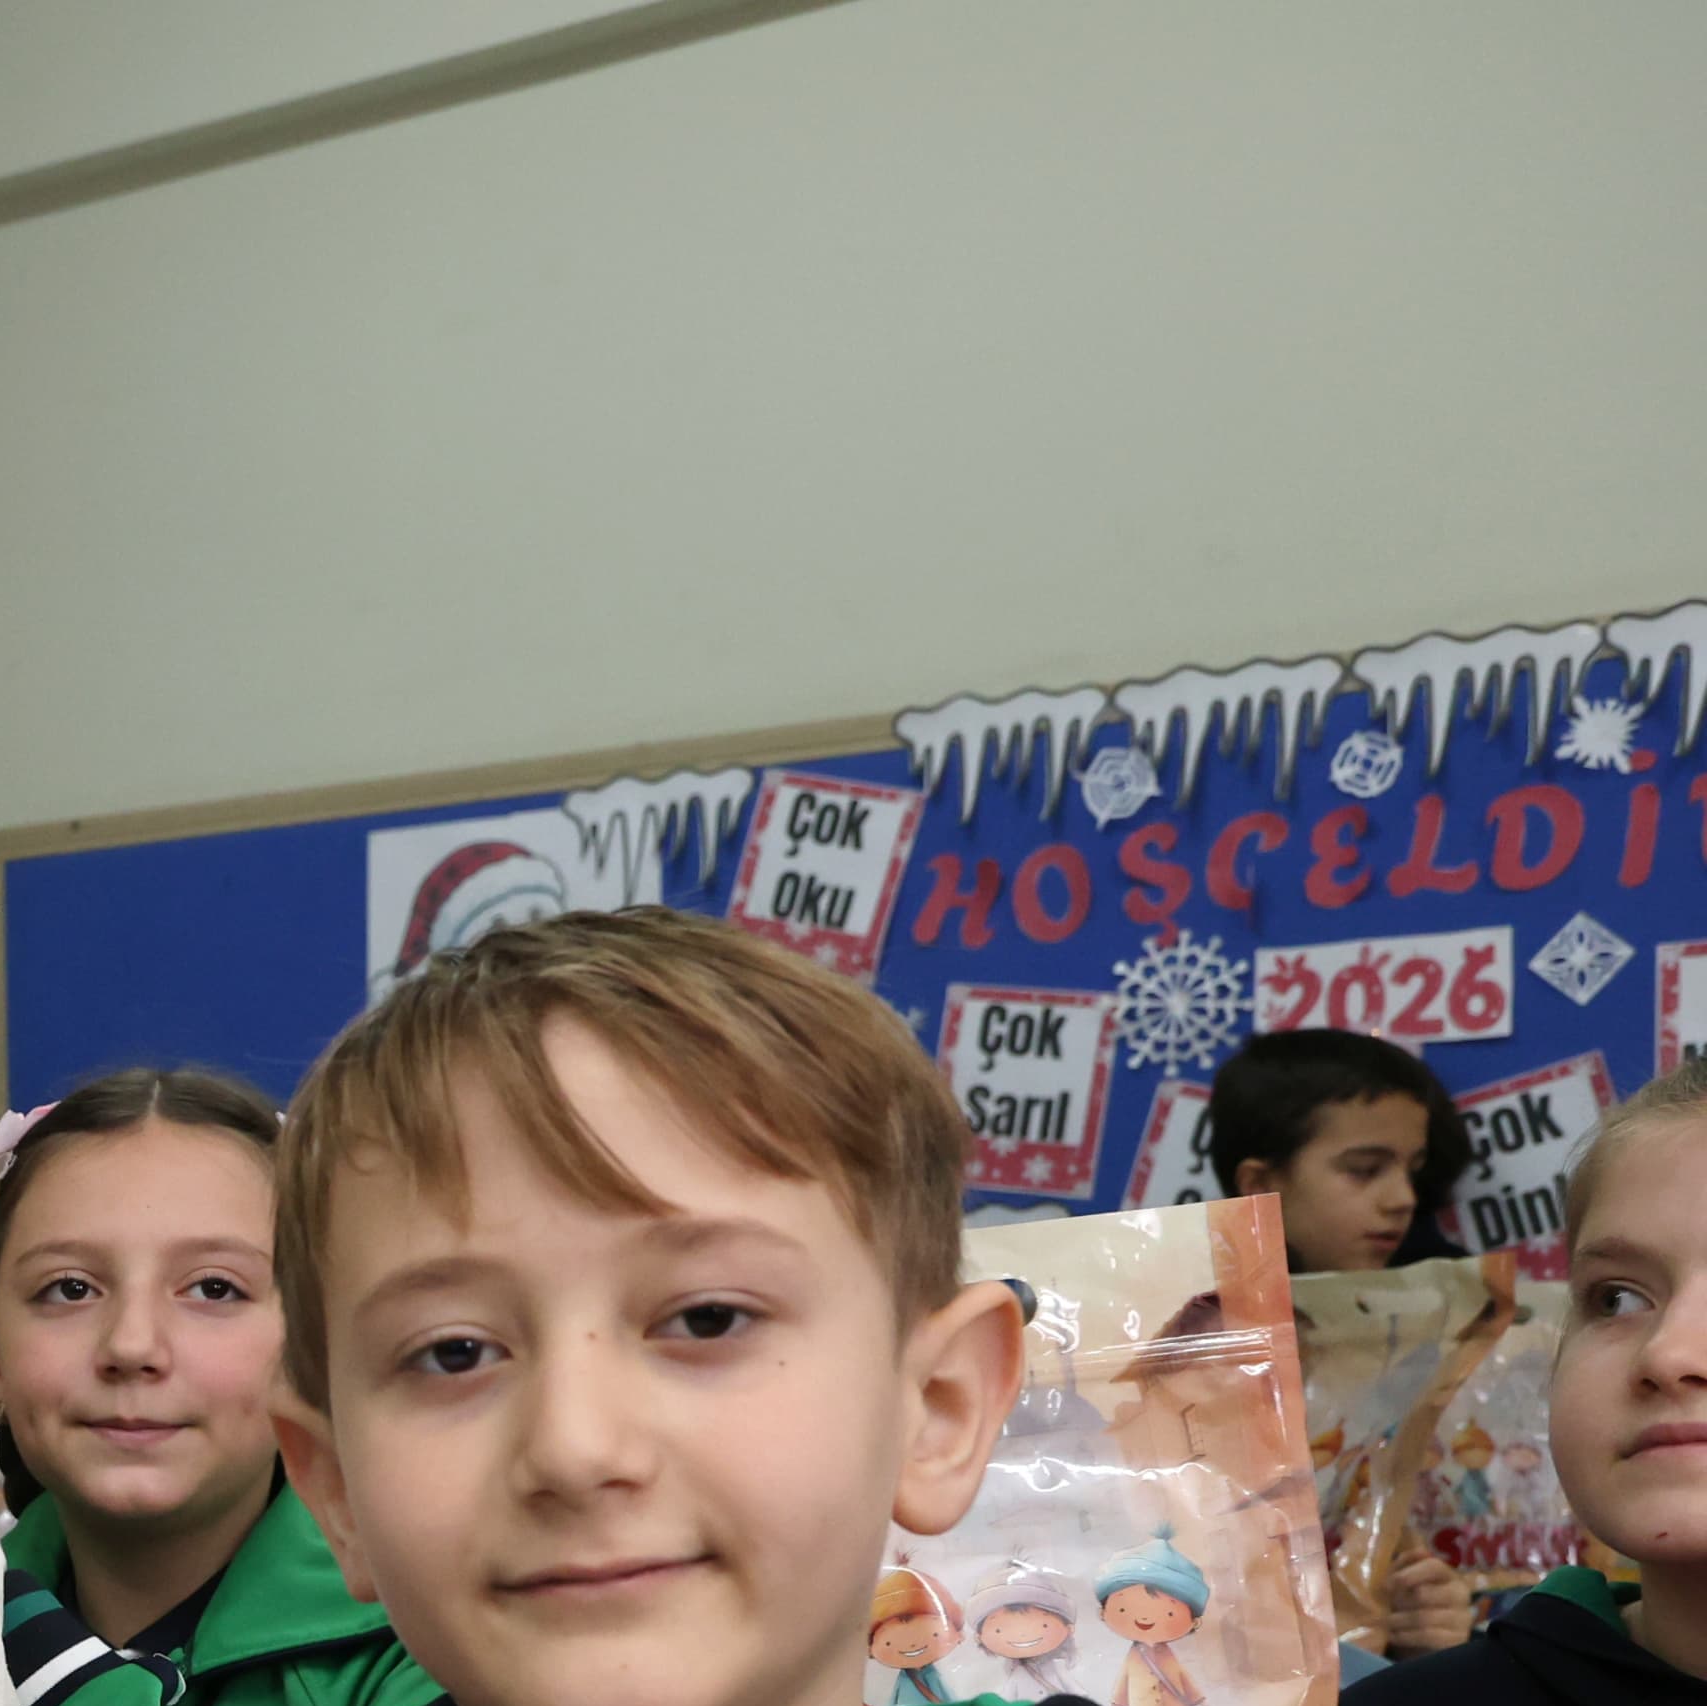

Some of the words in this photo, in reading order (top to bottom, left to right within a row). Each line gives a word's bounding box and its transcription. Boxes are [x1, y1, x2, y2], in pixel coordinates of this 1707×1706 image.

[784, 792, 870, 857] Çok
[912, 748, 1707, 948] HOŞGELDİ
[771, 871, 856, 930] Oku
[1259, 943, 1508, 1037] 2026
[978, 1003, 1068, 1071] Çok
[1461, 1090, 1564, 1182] Çok
